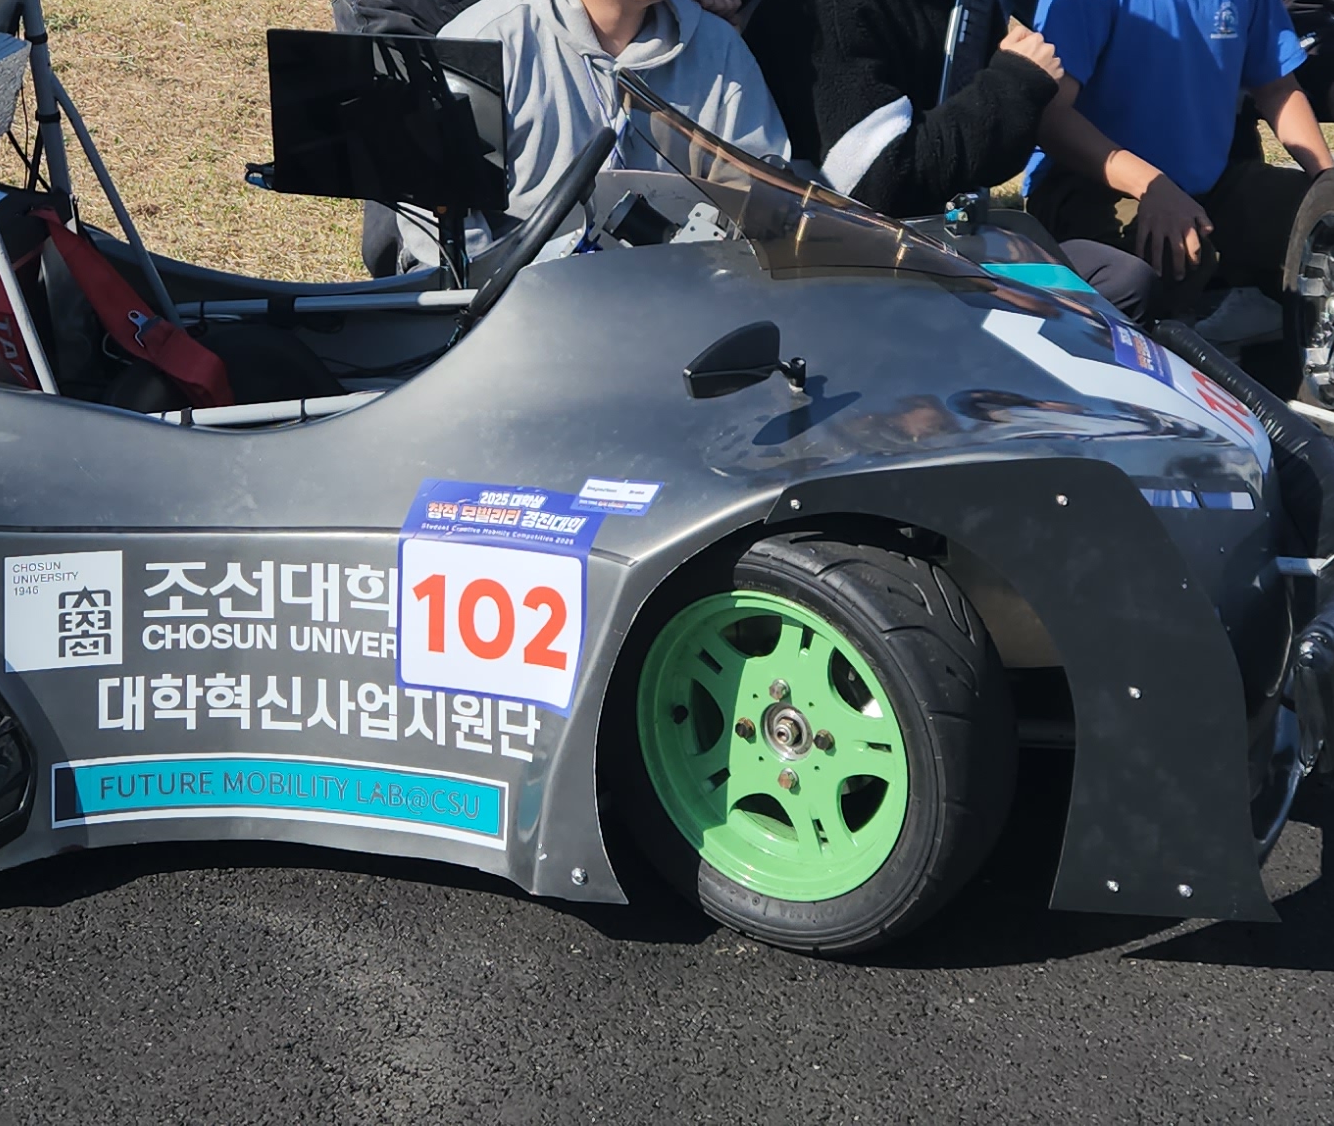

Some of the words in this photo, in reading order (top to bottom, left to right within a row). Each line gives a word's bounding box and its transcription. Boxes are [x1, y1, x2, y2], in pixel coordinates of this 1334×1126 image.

[479, 491, 509, 505] 2025
[509, 494, 547, 508] 대학생
[427, 502, 458, 521] 창작
[459, 505, 522, 526] 모빌리티
[521, 510, 588, 534] 경진대회
[12, 561, 62, 573] CHOSUN
[12, 571, 79, 585] UNIVERSITY
[13, 585, 40, 596] 1946
[142, 622, 277, 651] CHOSUN
[412, 574, 568, 671] 102
[98, 673, 541, 762] 대학혁신사업지원단
[100, 771, 212, 800] FUTURE
[222, 770, 349, 801] MOBILITY
[355, 781, 480, 819] LAB@CSU
